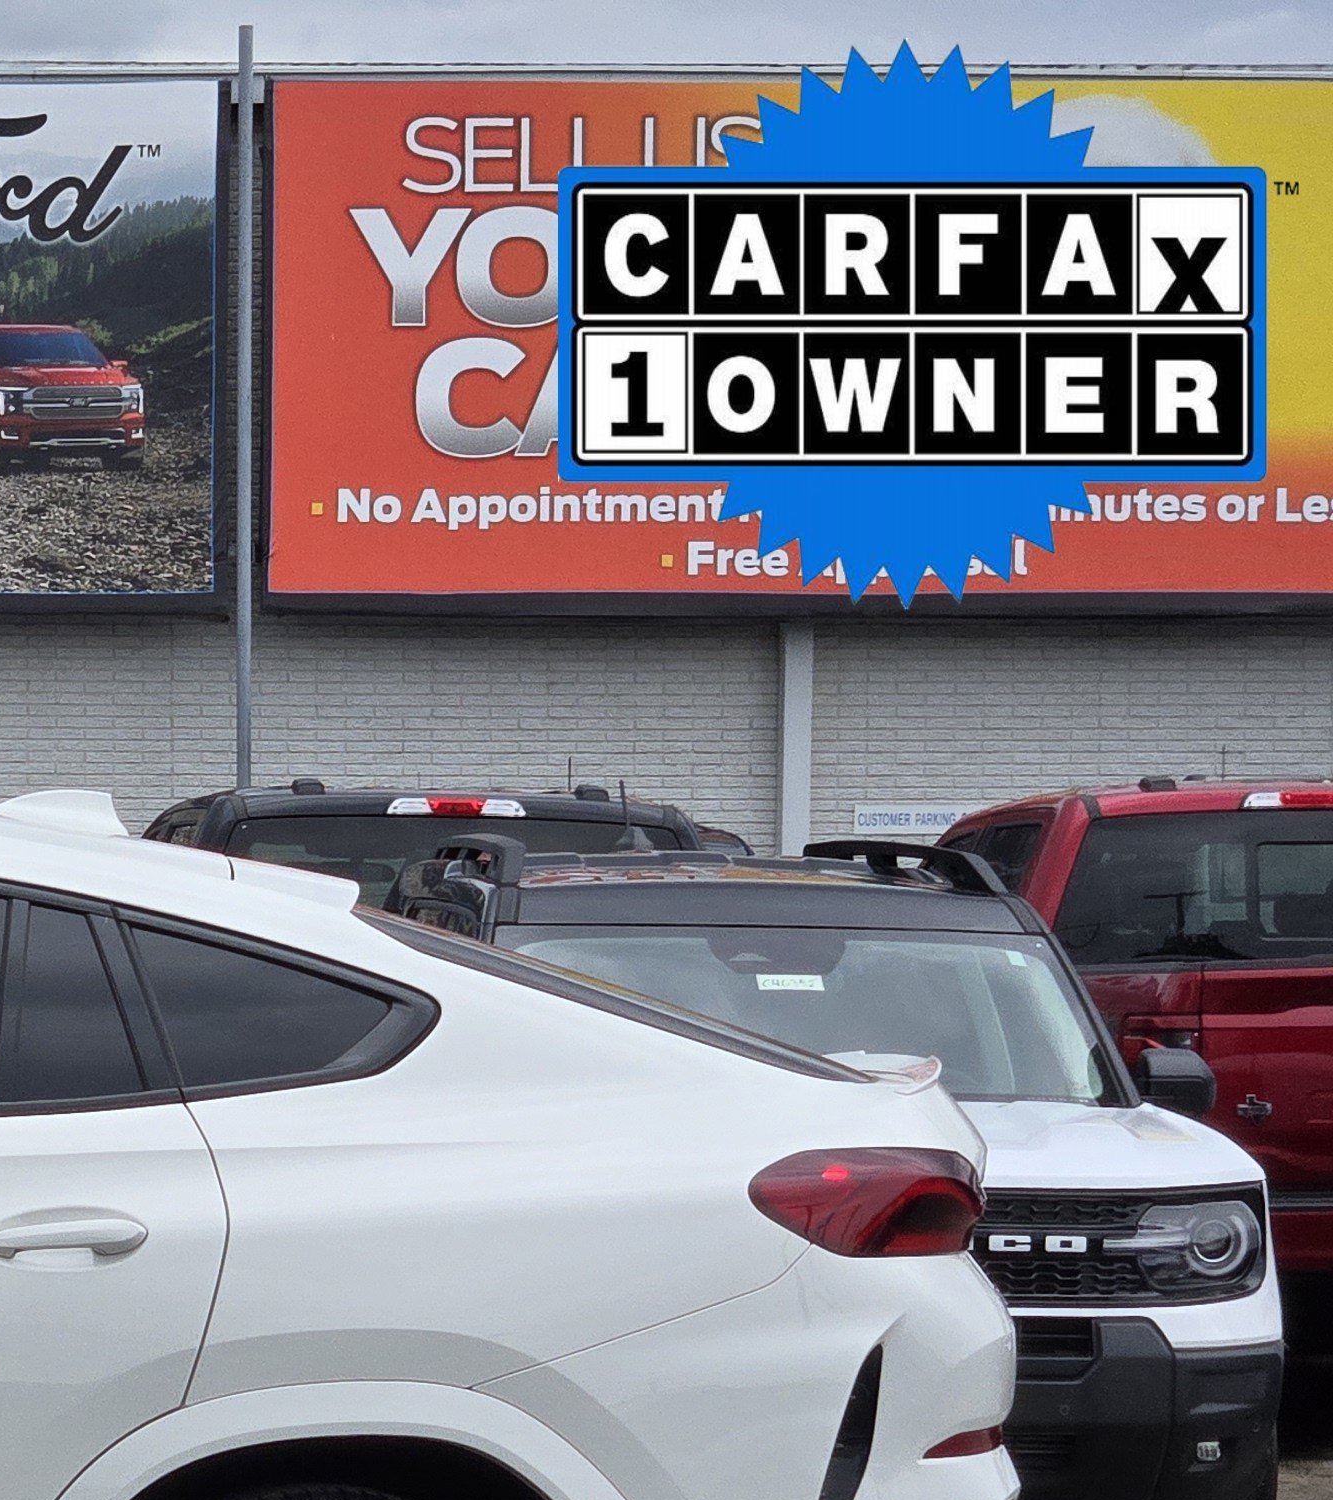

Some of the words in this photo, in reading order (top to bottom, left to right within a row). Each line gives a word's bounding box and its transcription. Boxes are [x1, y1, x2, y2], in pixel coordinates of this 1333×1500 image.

[337, 488, 402, 522] No
[1217, 494, 1265, 522] or
[1276, 487, 1333, 523] Le
[857, 813, 911, 827] CUSTOMER
